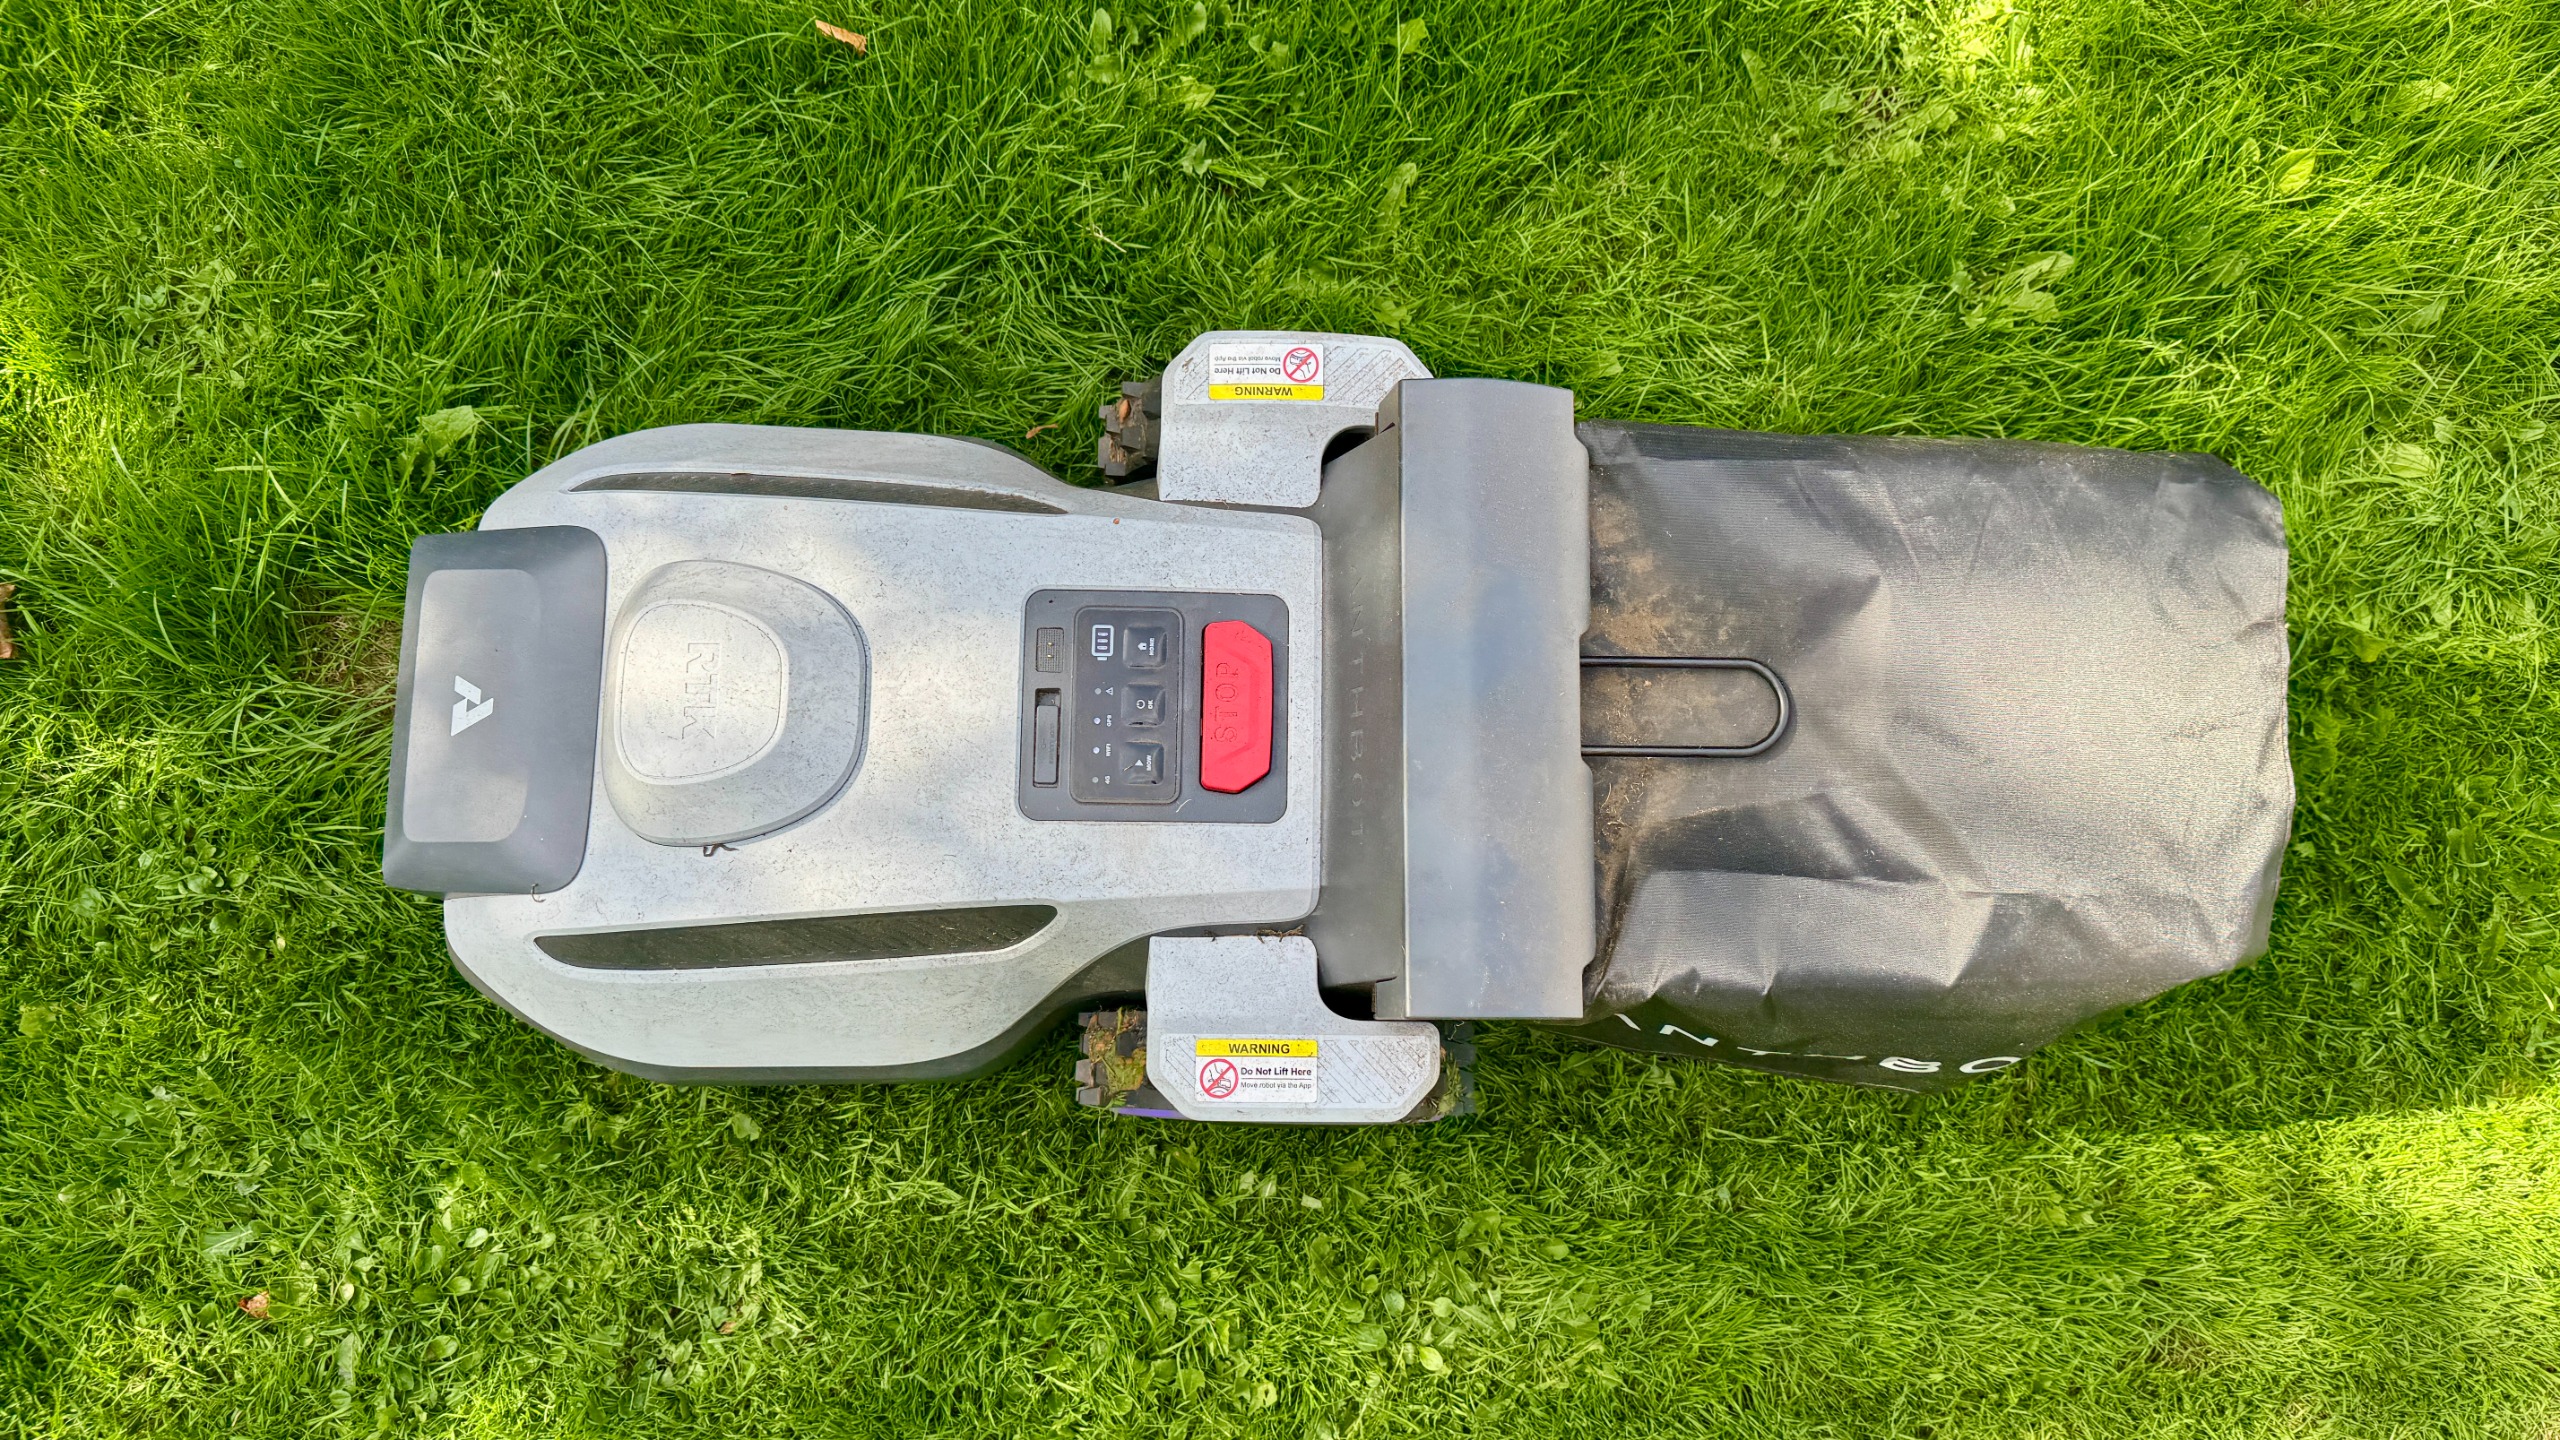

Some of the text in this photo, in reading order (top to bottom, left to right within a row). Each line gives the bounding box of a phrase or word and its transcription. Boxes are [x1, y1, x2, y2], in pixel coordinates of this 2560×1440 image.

[1214, 367, 1281, 375] Do Not Lift Here
[1235, 386, 1293, 396] WARNING
[681, 642, 722, 740] RTK
[1147, 700, 1154, 710] OK
[1214, 662, 1239, 743] STOP
[1105, 775, 1111, 785] 4G
[1229, 1043, 1290, 1054] WARNING
[1240, 1066, 1312, 1076] Do Not Lift Here
[1299, 1082, 1312, 1090] App
